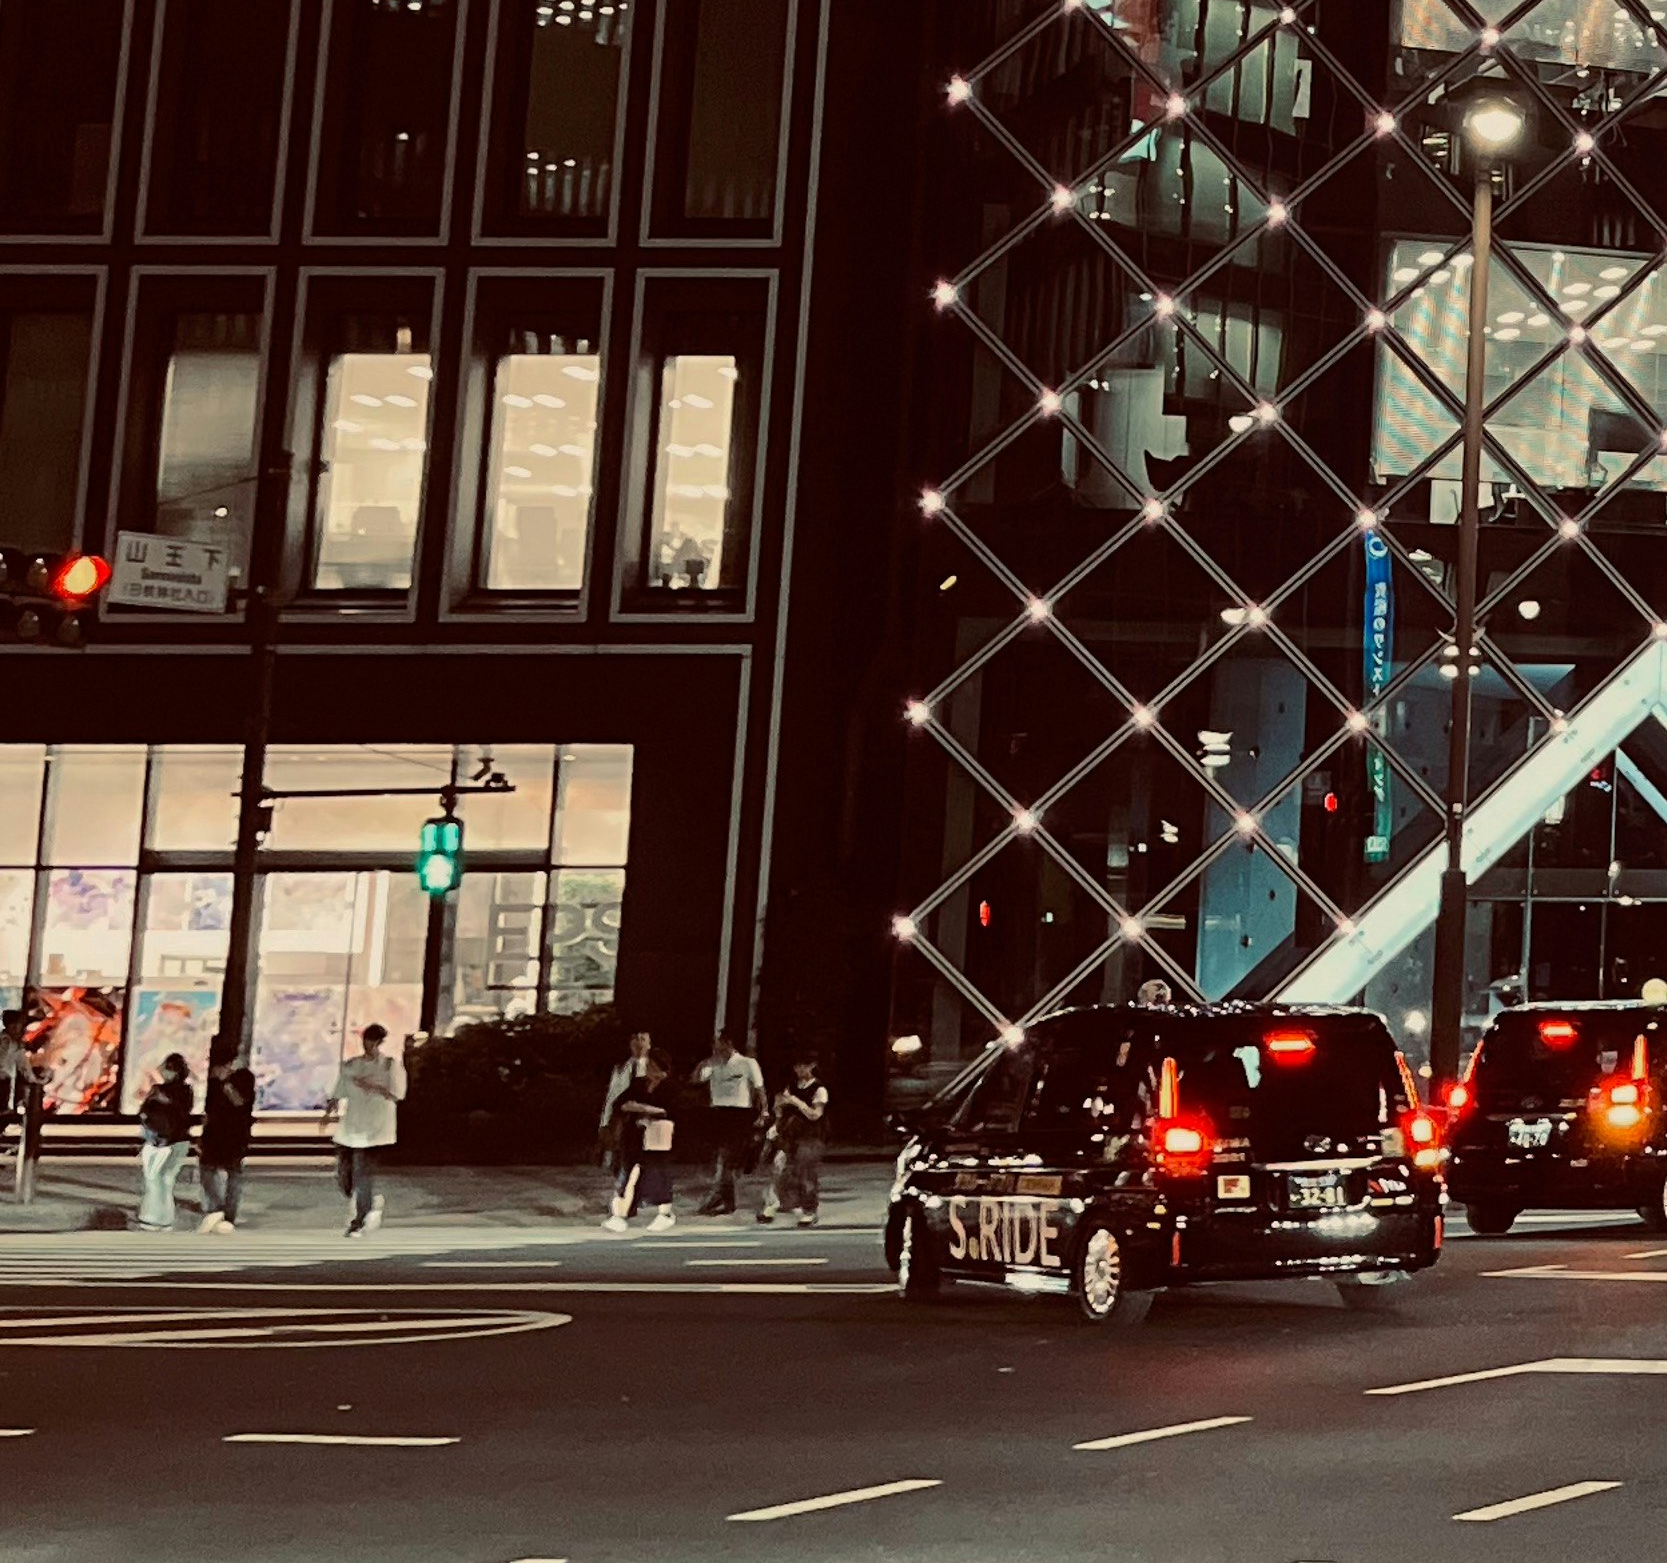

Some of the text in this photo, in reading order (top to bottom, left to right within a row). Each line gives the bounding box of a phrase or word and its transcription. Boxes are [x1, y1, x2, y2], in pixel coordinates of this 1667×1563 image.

[127, 541, 223, 570] 山王下
[948, 1195, 1061, 1267] S.RIDE
